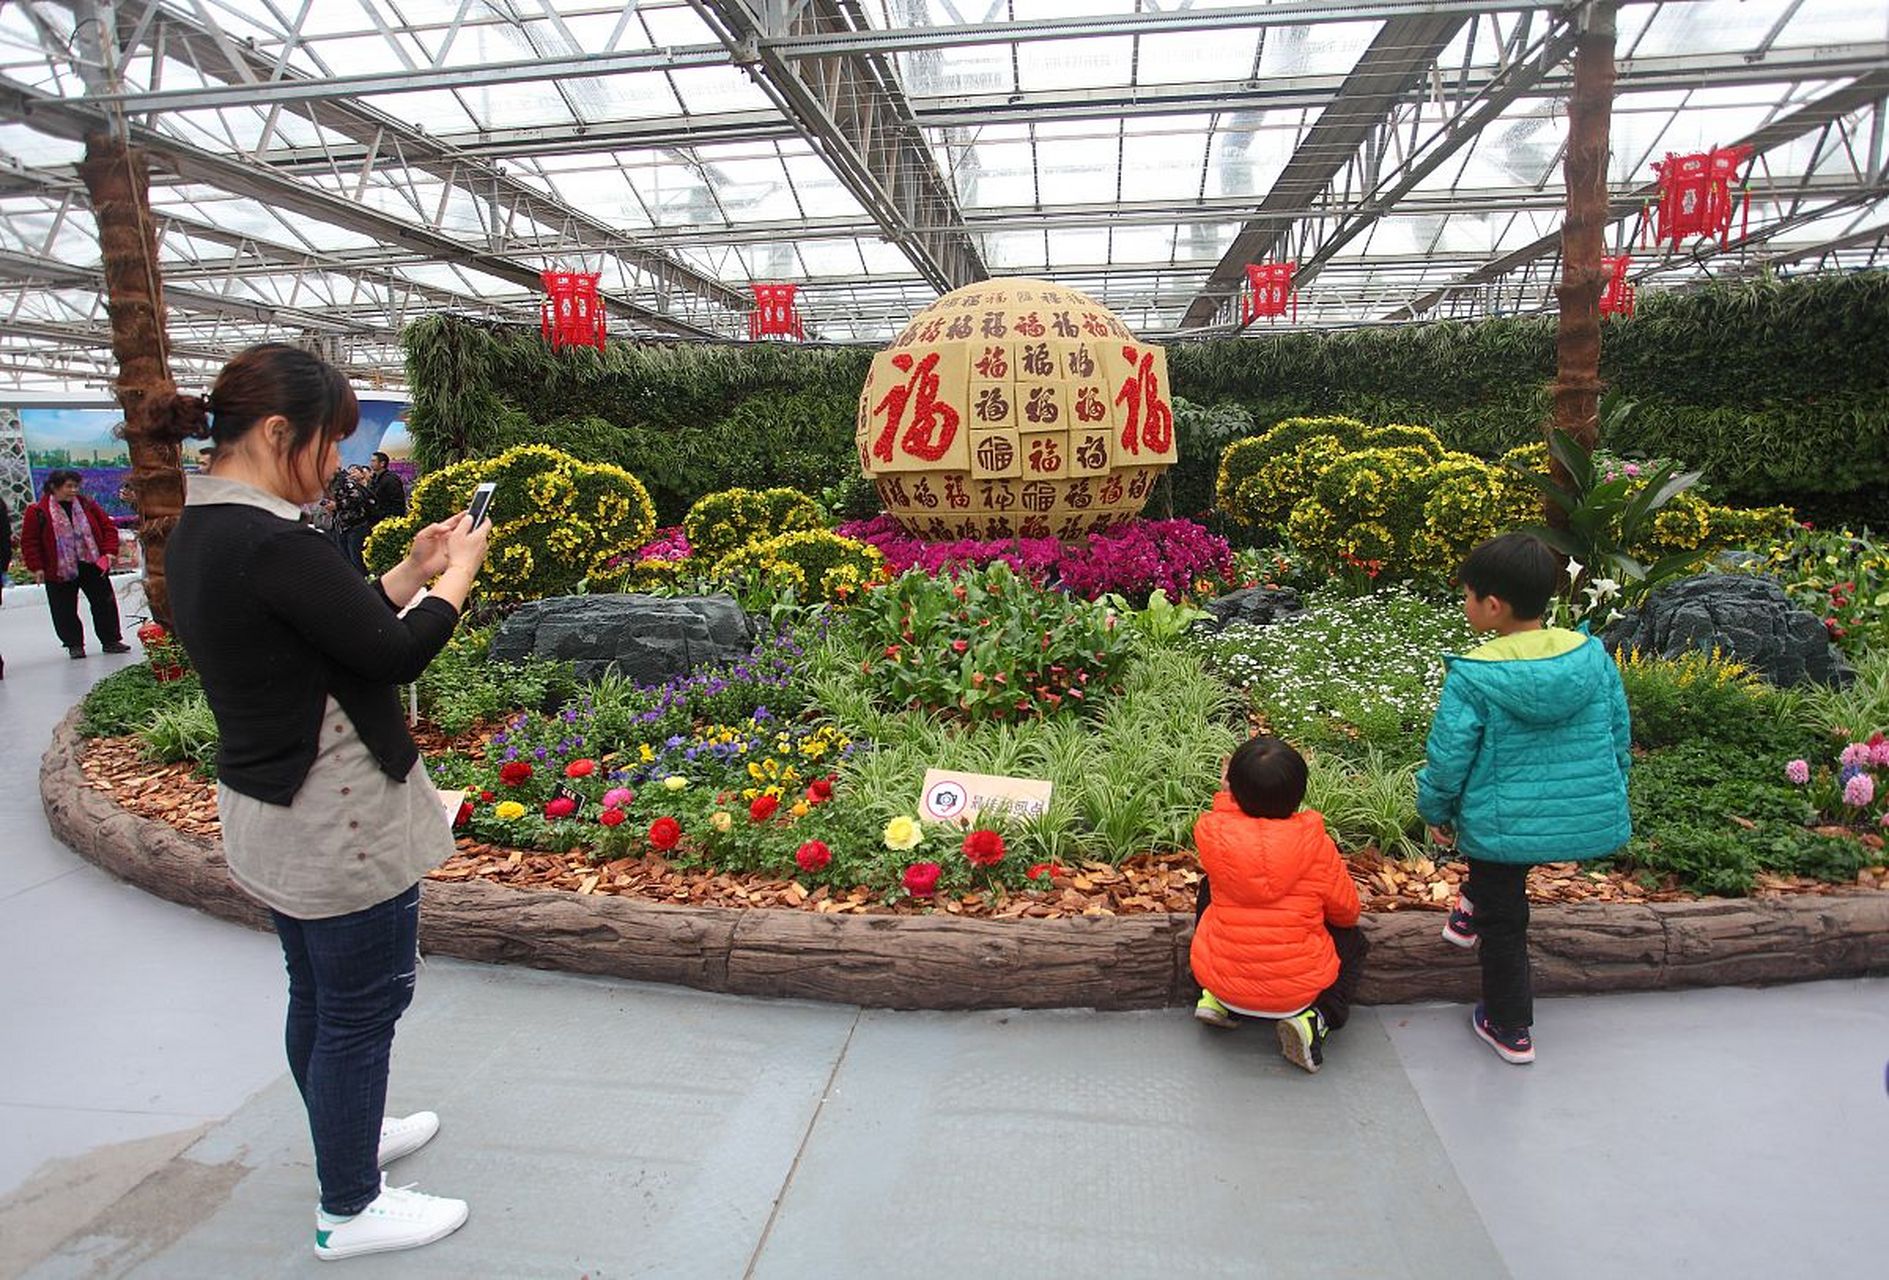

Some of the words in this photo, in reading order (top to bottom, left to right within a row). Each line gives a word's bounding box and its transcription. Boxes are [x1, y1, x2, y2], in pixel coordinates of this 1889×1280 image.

[946, 314, 973, 340] 福
[981, 312, 1008, 339] 福
[1014, 311, 1046, 338] 福
[1051, 311, 1080, 338] 福
[1082, 312, 1109, 338] 福
[973, 345, 1009, 378] 福
[1021, 342, 1054, 377] 福
[1067, 342, 1095, 378] 福
[873, 352, 960, 462] 福
[973, 386, 1010, 421] 福
[1024, 386, 1059, 423] 福
[1075, 386, 1106, 422] 福
[1115, 345, 1172, 456] 福
[977, 435, 1014, 472] 福
[1028, 438, 1061, 472] 福
[1076, 435, 1108, 469] 福
[912, 476, 939, 508] 福
[943, 474, 971, 509] 福
[1021, 480, 1056, 512] 福
[1064, 477, 1093, 509] 福
[1100, 474, 1124, 504] 福
